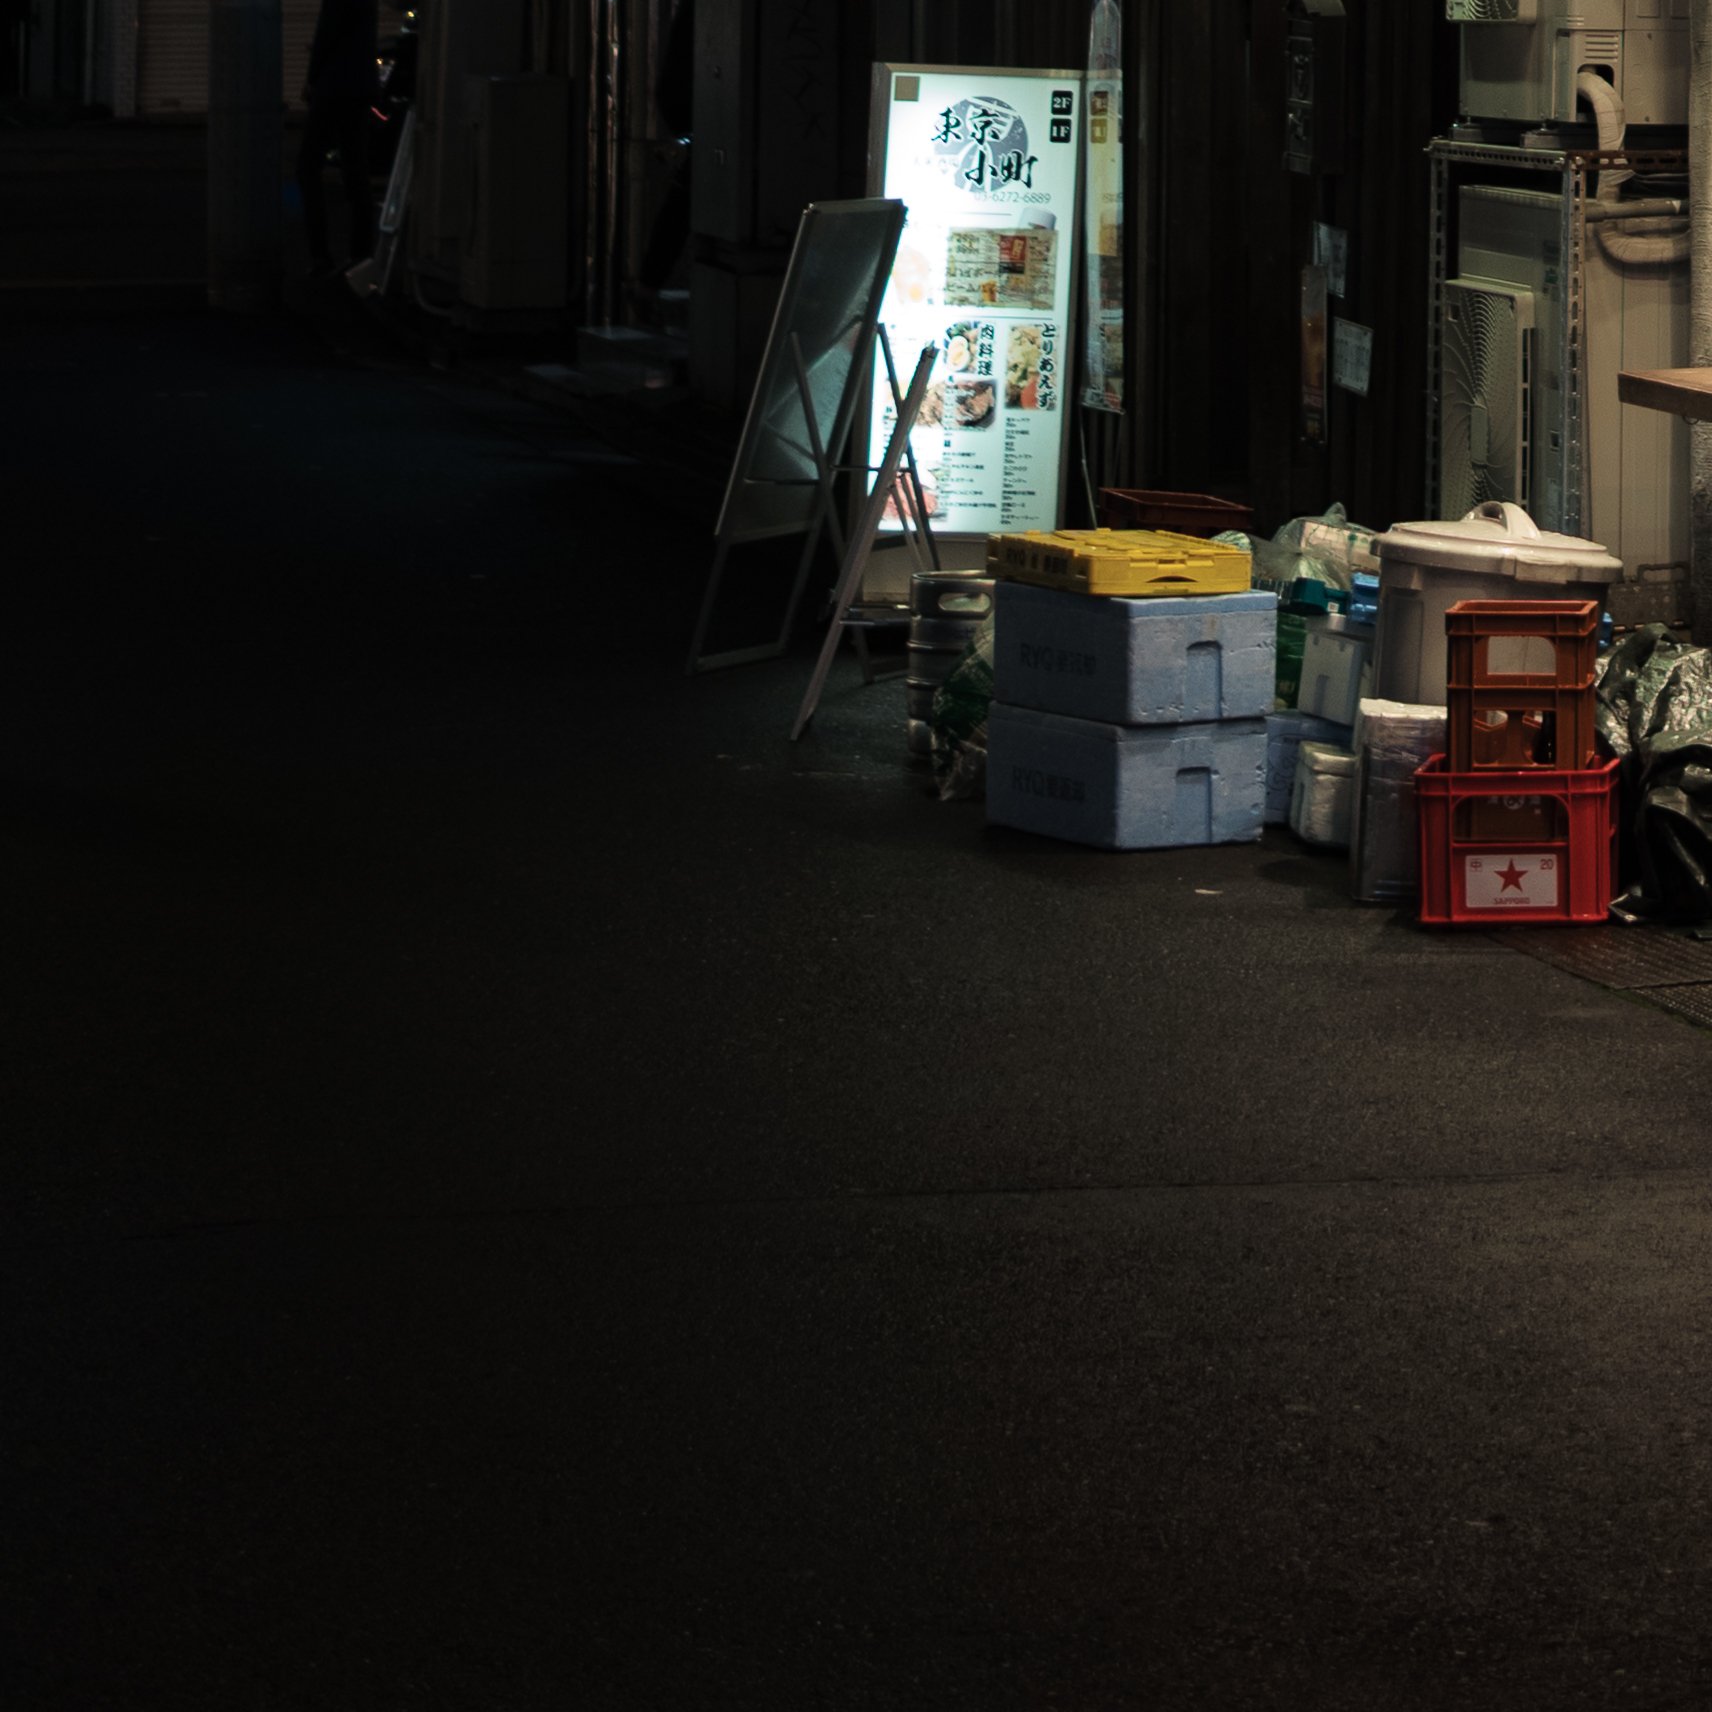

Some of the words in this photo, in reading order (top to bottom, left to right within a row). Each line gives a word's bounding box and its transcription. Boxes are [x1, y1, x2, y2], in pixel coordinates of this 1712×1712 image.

[1052, 96, 1073, 109] 2F
[930, 106, 1001, 146] 東京
[1051, 125, 1071, 138] 1F
[977, 322, 996, 377] 肉料理
[1038, 322, 1057, 410] とりあえず
